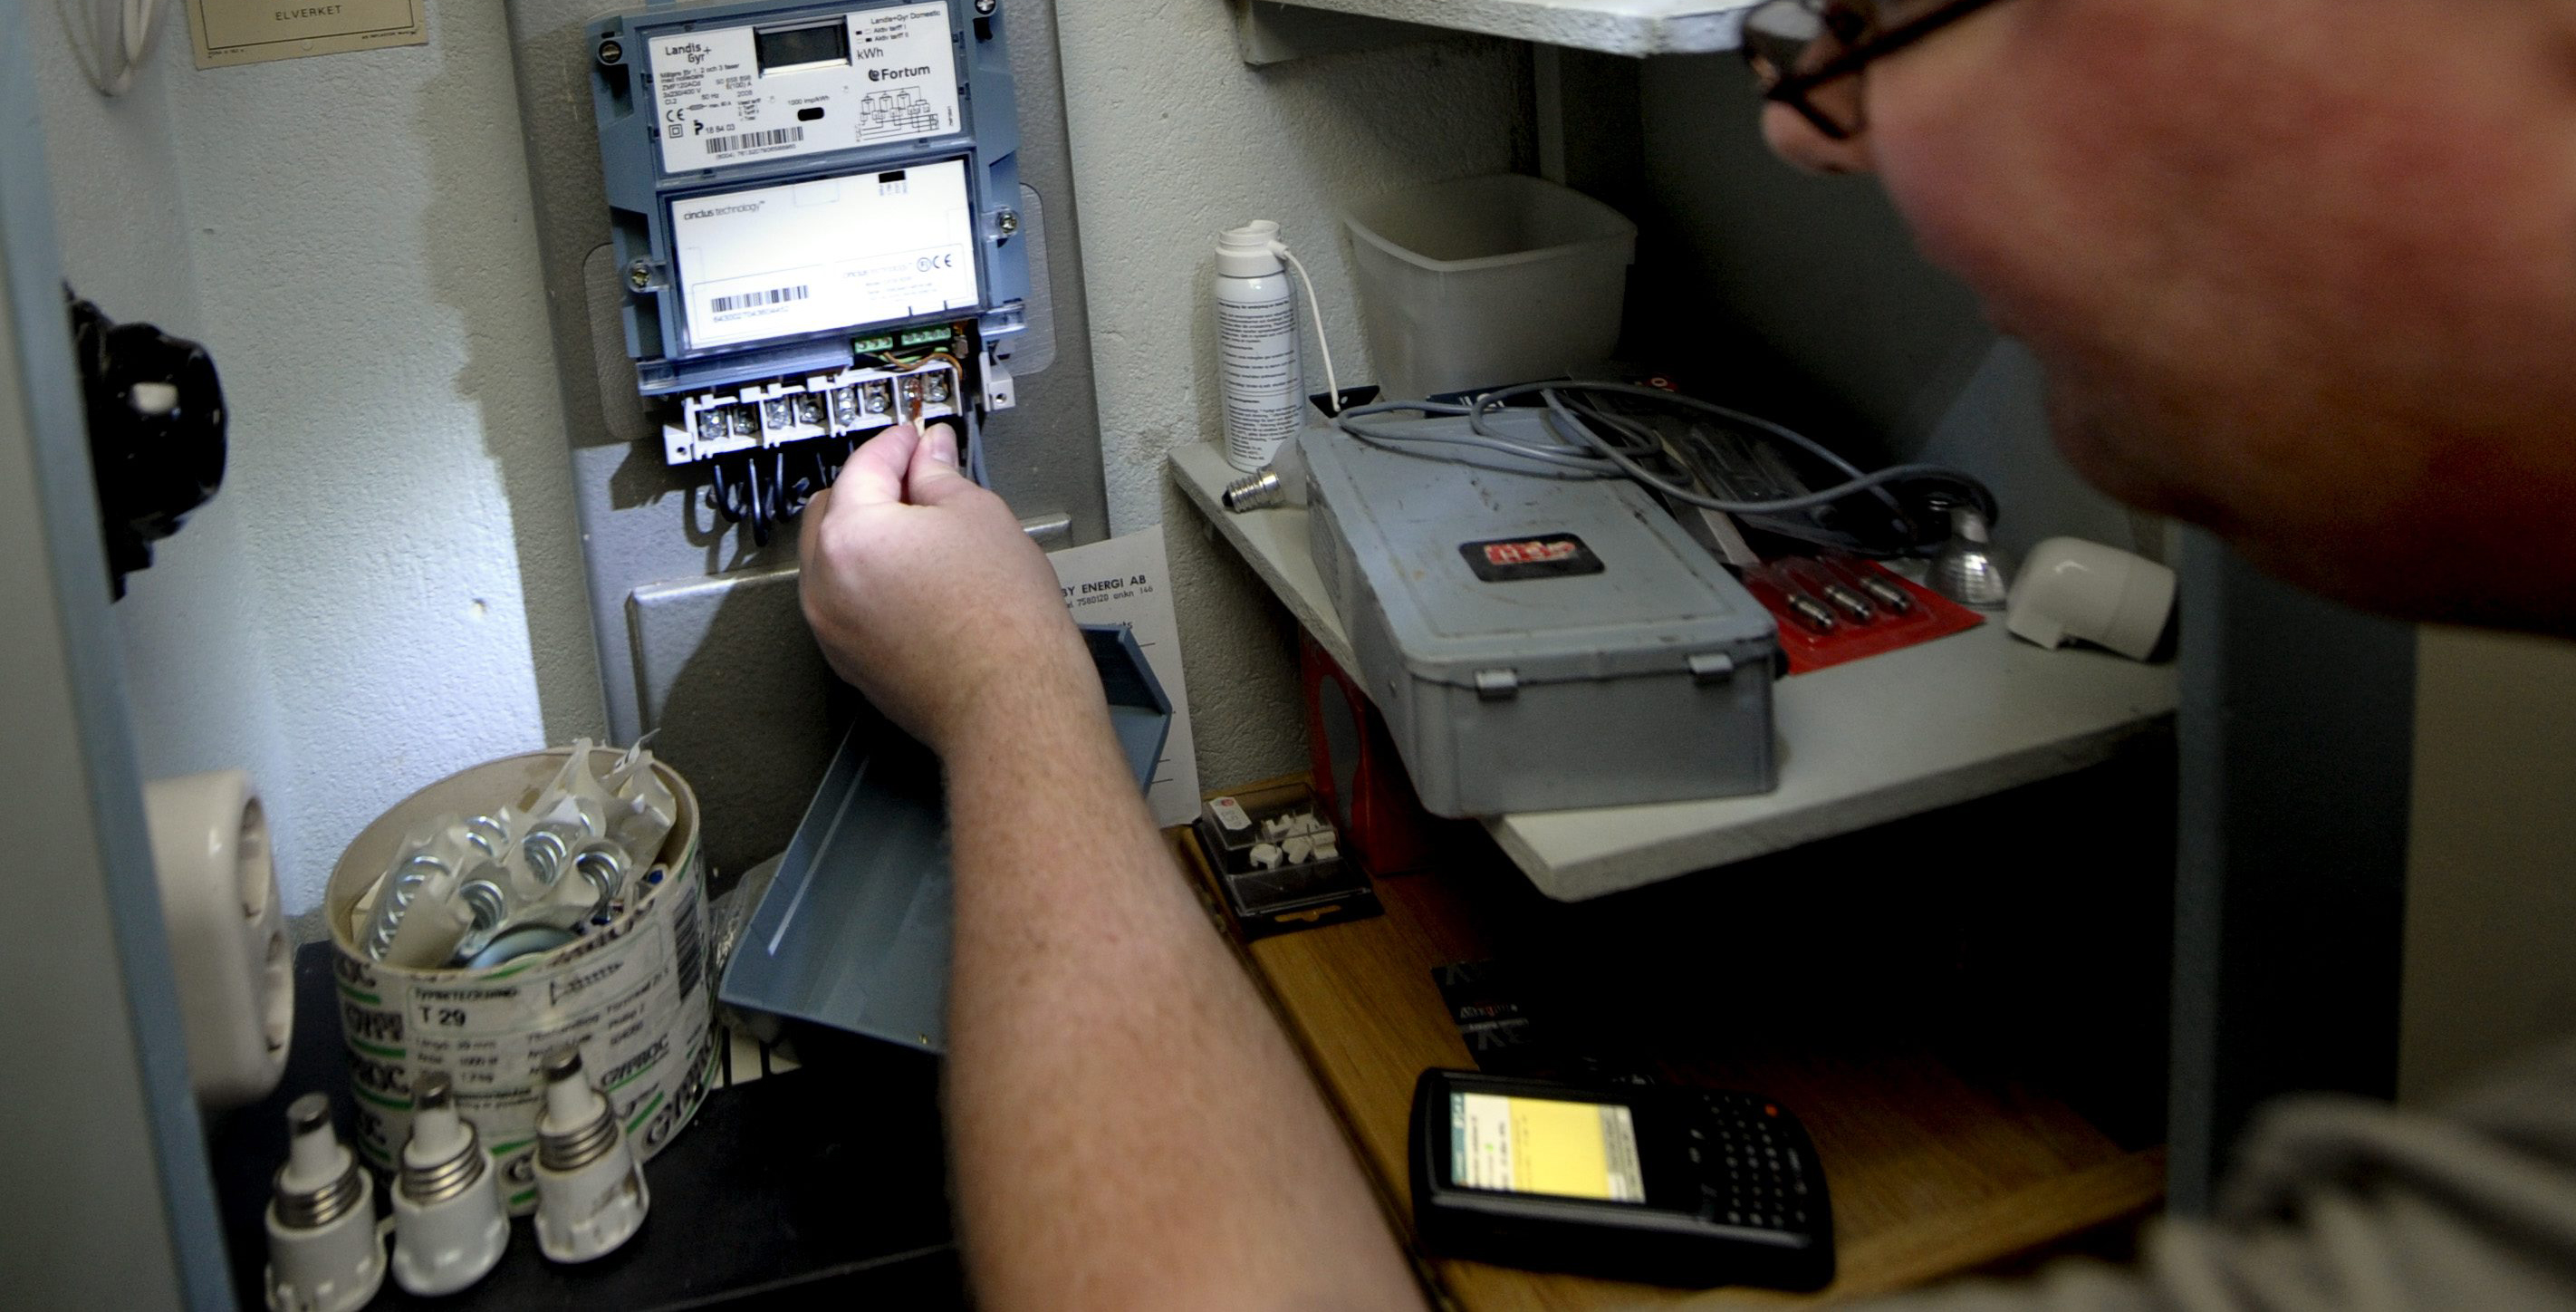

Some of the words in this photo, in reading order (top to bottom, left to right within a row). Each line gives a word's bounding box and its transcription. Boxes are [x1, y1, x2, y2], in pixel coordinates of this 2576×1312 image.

[275, 5, 343, 21] ELVERKET
[688, 53, 706, 64] Gyr
[857, 47, 884, 60] kWh
[882, 66, 931, 81] Fortum
[684, 209, 715, 220] cinclus
[1062, 586, 1075, 597] BY
[1082, 578, 1124, 593] ENERGI
[1130, 574, 1147, 586] AB
[1077, 593, 1110, 607] 7580120
[419, 1006, 430, 1024] T
[439, 1008, 466, 1027] 29
